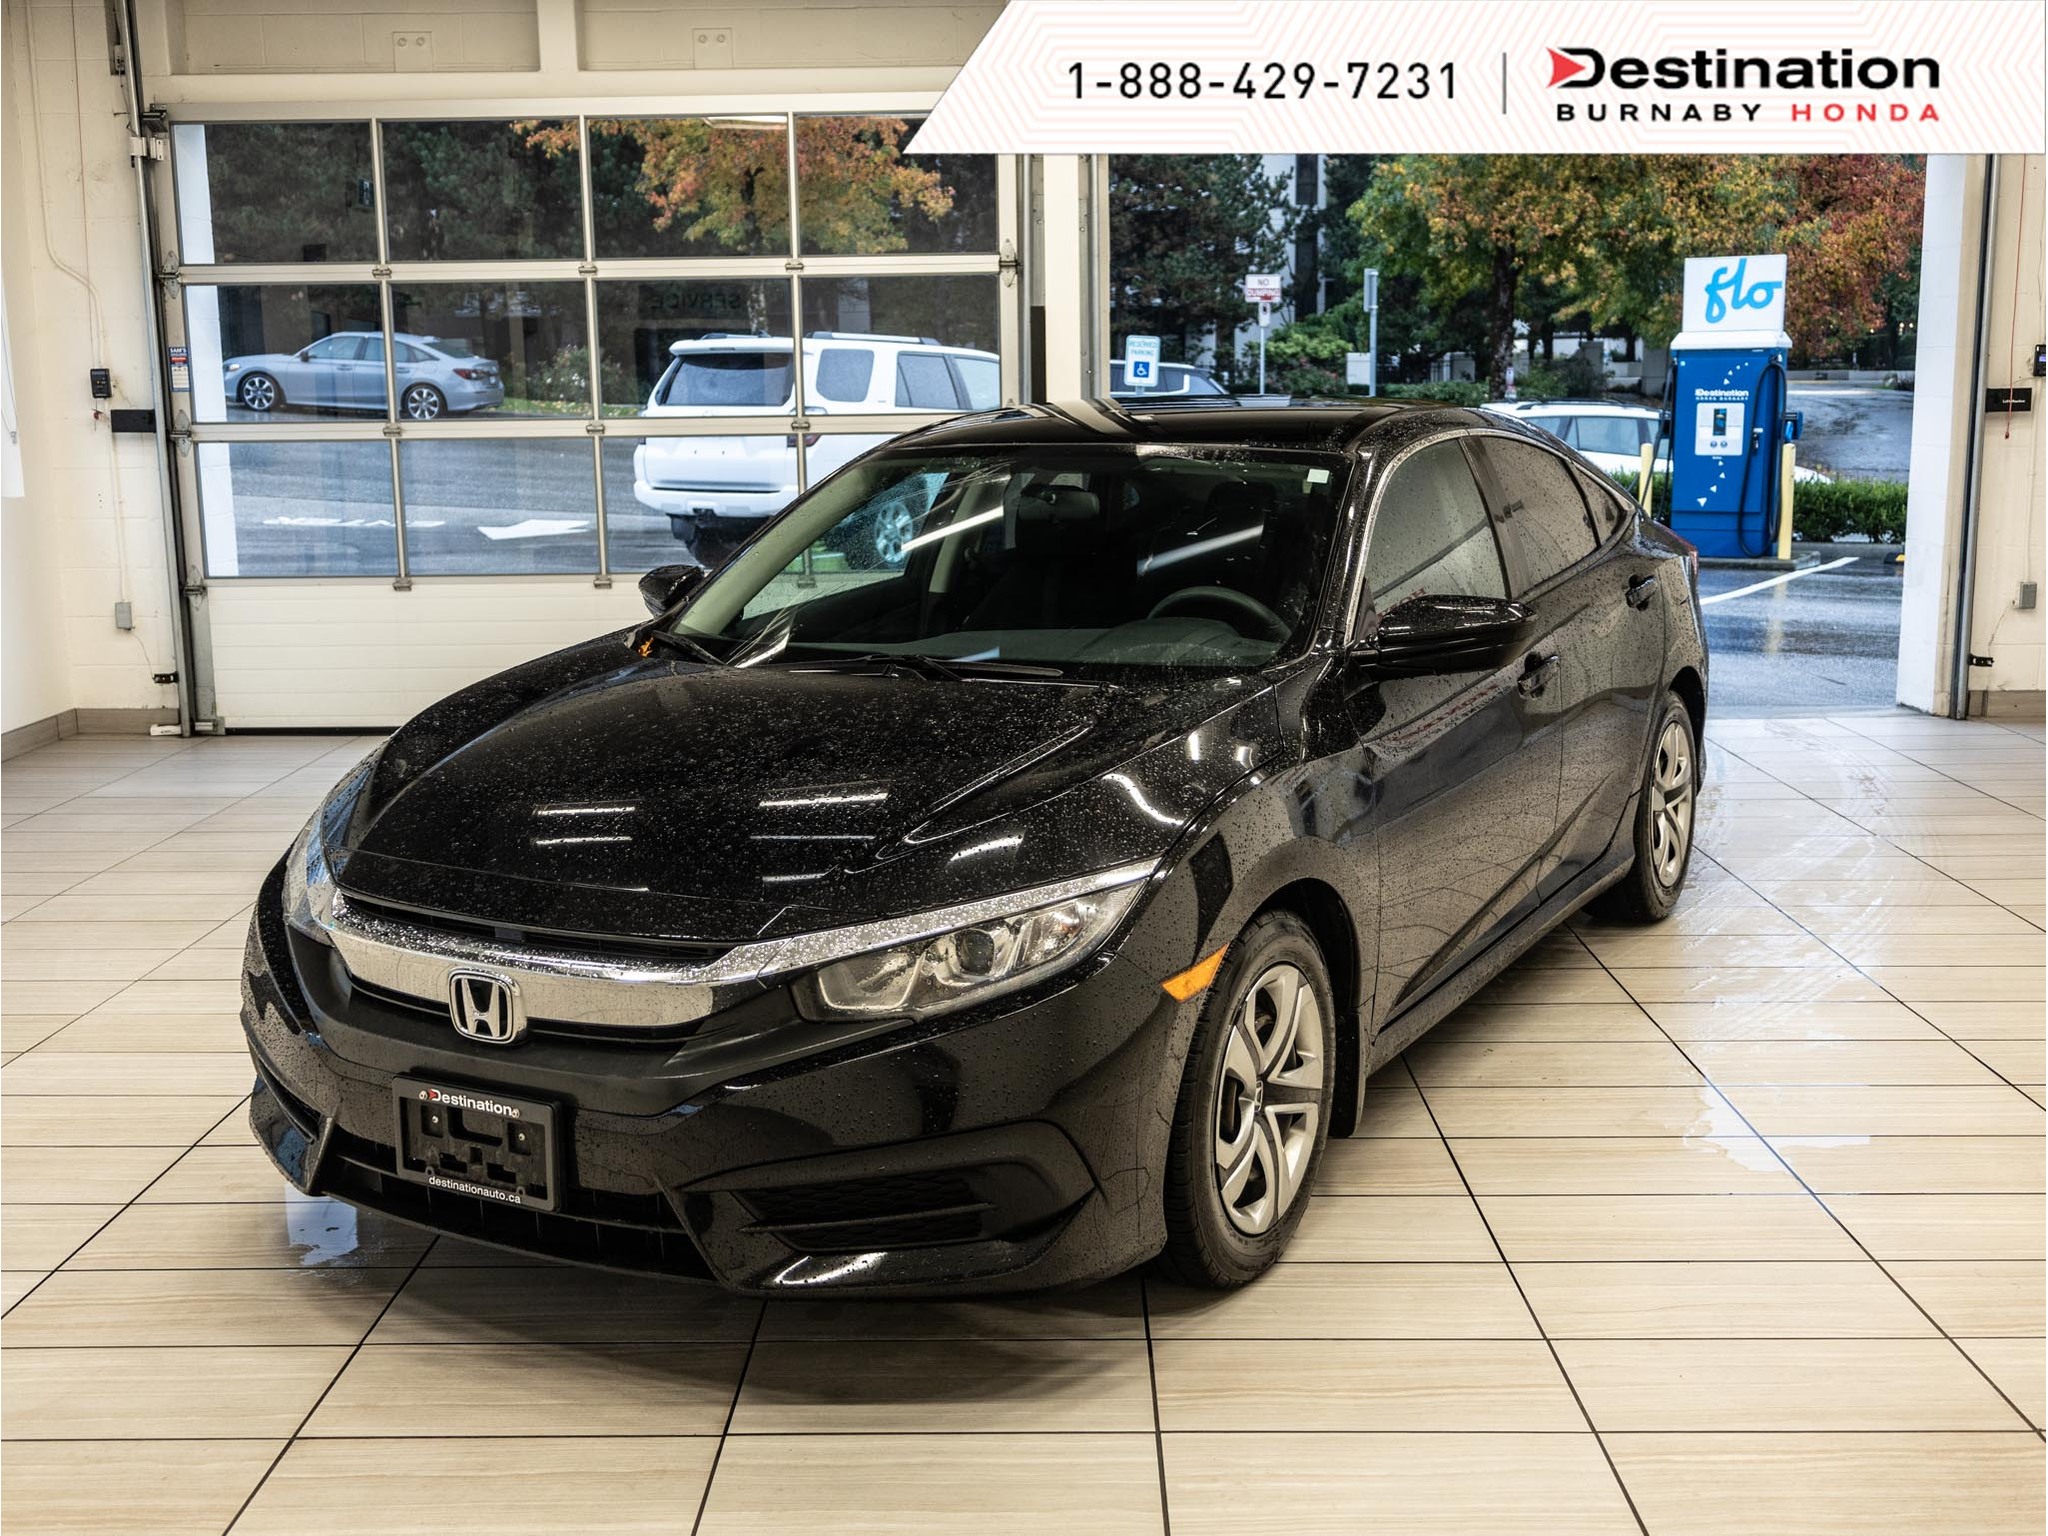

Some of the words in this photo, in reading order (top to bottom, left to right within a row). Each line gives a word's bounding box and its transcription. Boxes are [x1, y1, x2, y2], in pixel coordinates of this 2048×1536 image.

[1257, 278, 1270, 287] NO
[1704, 257, 1783, 324] flo
[1695, 388, 1749, 397] Destination
[427, 1088, 513, 1117] Destination
[428, 1175, 521, 1204] destinationauto.ca
